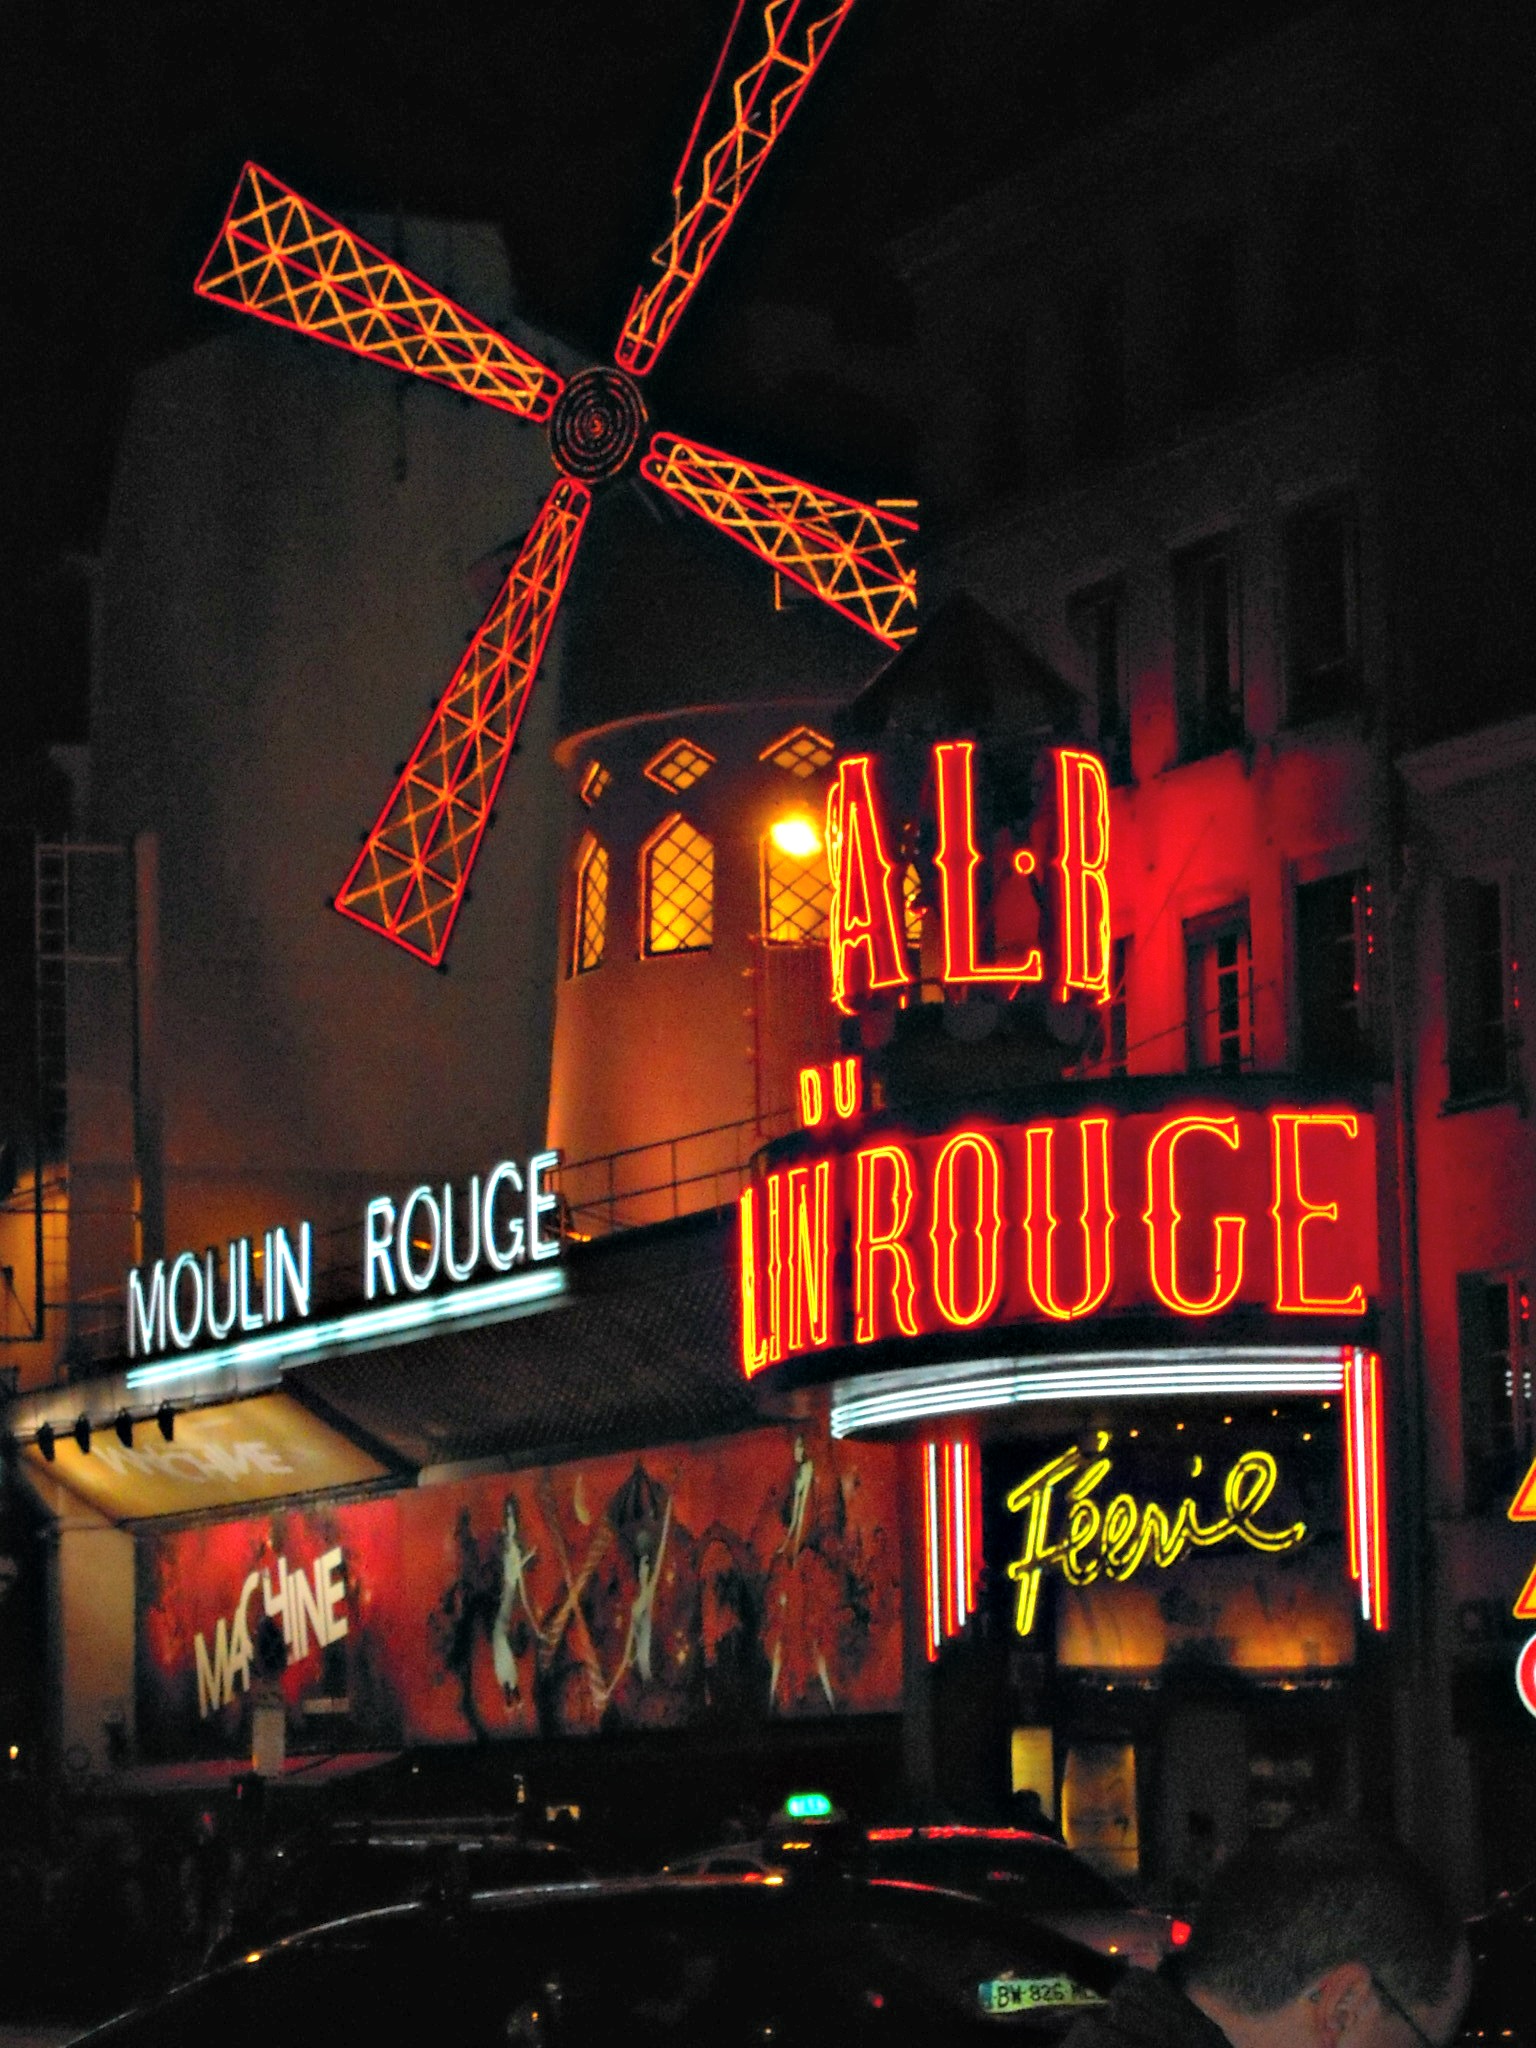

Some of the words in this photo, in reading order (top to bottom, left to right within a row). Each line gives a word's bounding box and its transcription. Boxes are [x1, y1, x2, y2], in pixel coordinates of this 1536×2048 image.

[799, 1057, 857, 1127] DU
[128, 1220, 312, 1359] MOULIN
[364, 1150, 561, 1300] ROUGE
[855, 1114, 1367, 1343] ROUGE
[193, 1546, 350, 1720] MACHINE
